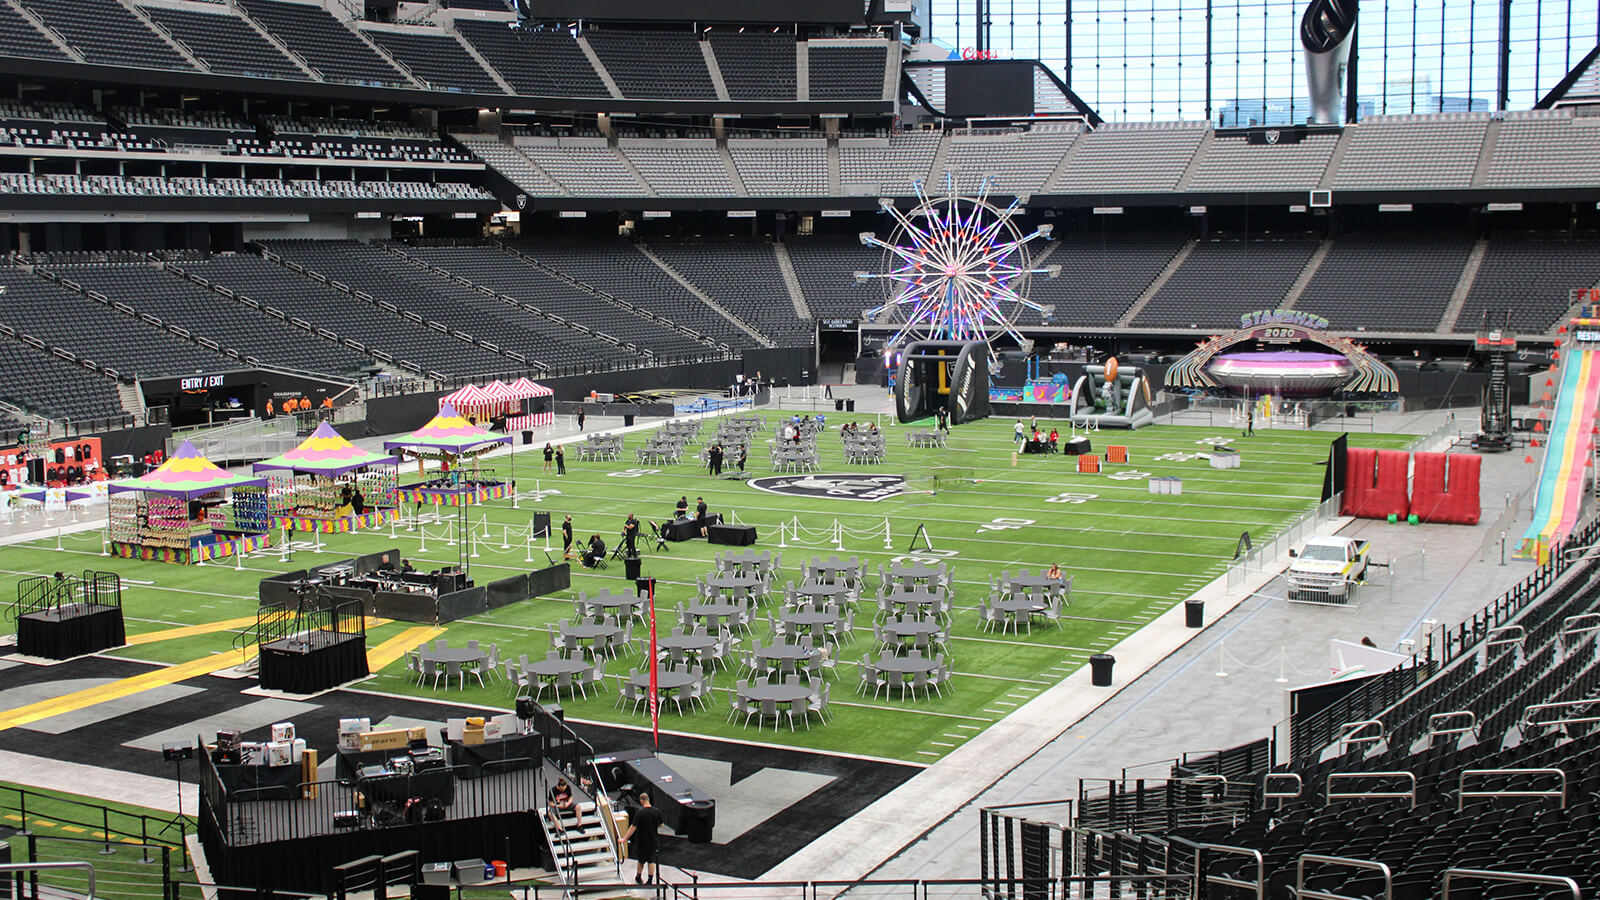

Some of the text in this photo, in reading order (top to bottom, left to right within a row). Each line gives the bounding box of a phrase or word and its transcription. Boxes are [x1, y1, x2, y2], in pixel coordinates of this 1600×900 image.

[962, 46, 998, 60] Coors
[1241, 310, 1329, 329] STARSHIP
[1264, 328, 1295, 338] 2020
[181, 377, 203, 390] ENTRY
[209, 374, 224, 387] EXIT
[1044, 492, 1100, 504] 50
